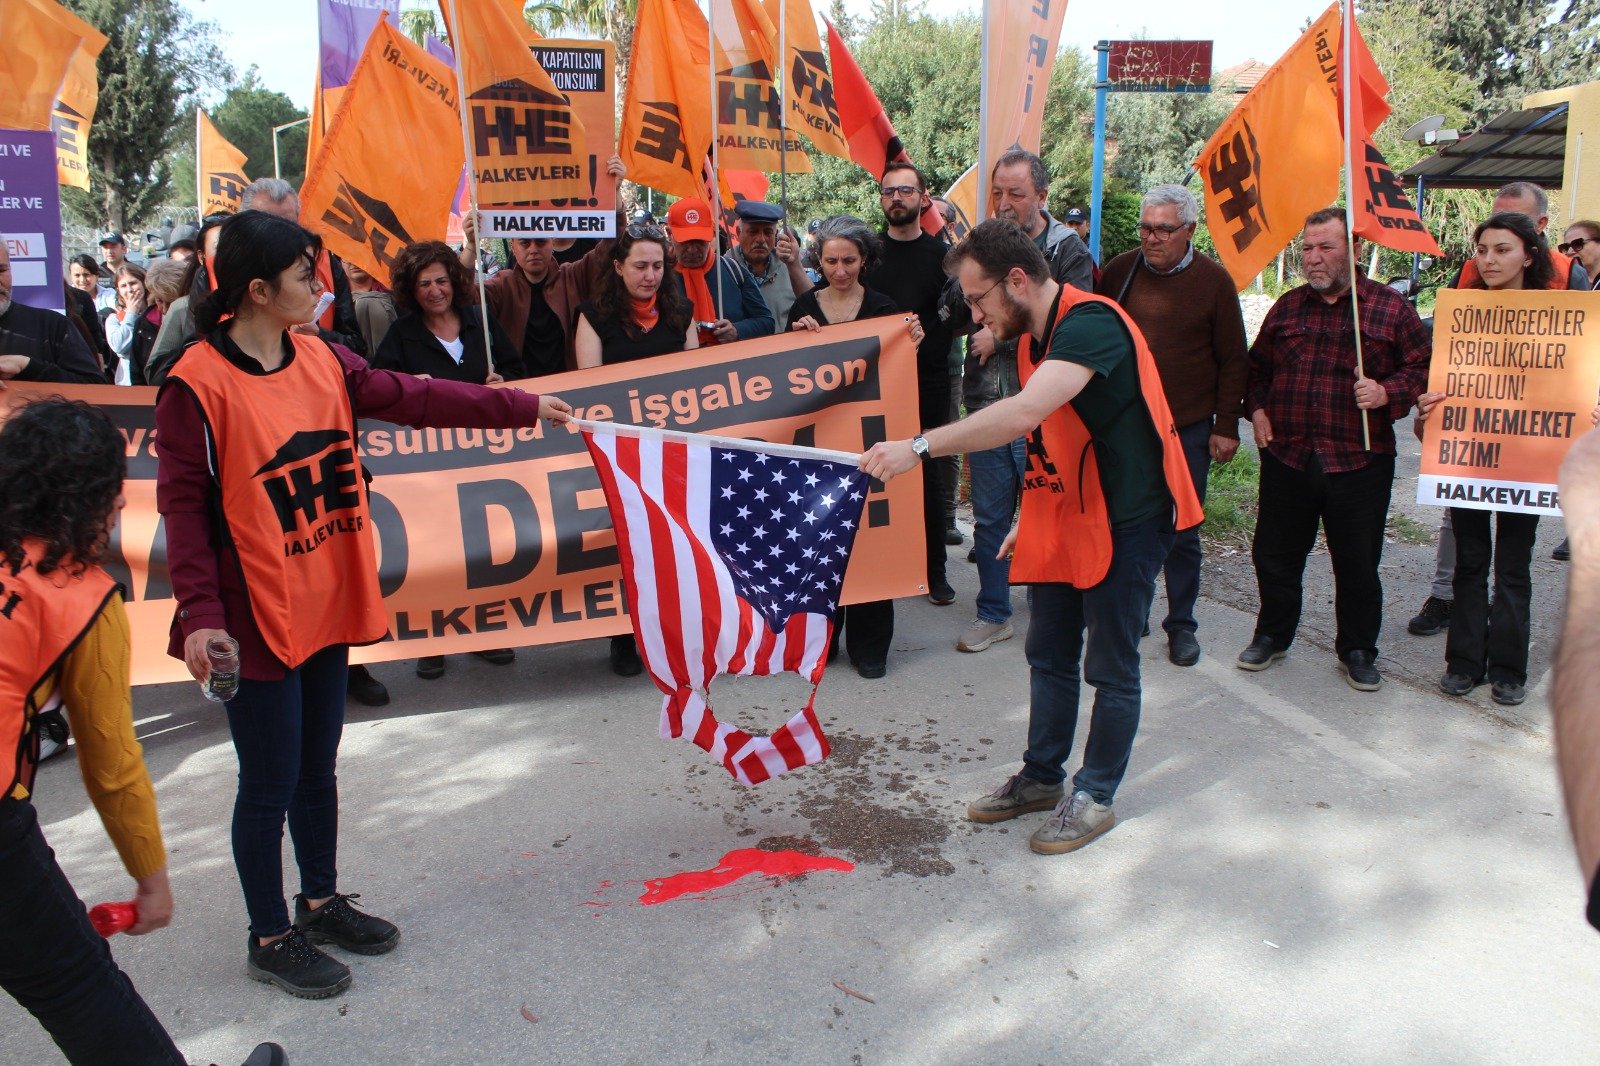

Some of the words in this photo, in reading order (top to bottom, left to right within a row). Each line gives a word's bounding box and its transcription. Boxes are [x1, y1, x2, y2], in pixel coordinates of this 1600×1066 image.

[543, 51, 602, 70] KAPATILSIN
[11, 144, 31, 156] VE
[23, 197, 43, 209] VE
[1451, 305, 1585, 336] SÖMÜRGECİLER
[1448, 336, 1567, 372] İŞBİRLİKÇİLER
[628, 371, 773, 429] işgale
[787, 358, 867, 396] son
[1446, 372, 1526, 401] DEFOLUN!
[1442, 405, 1467, 432] BU
[1473, 407, 1576, 438] MEMLEKET
[1438, 437, 1501, 468] BİZİM!
